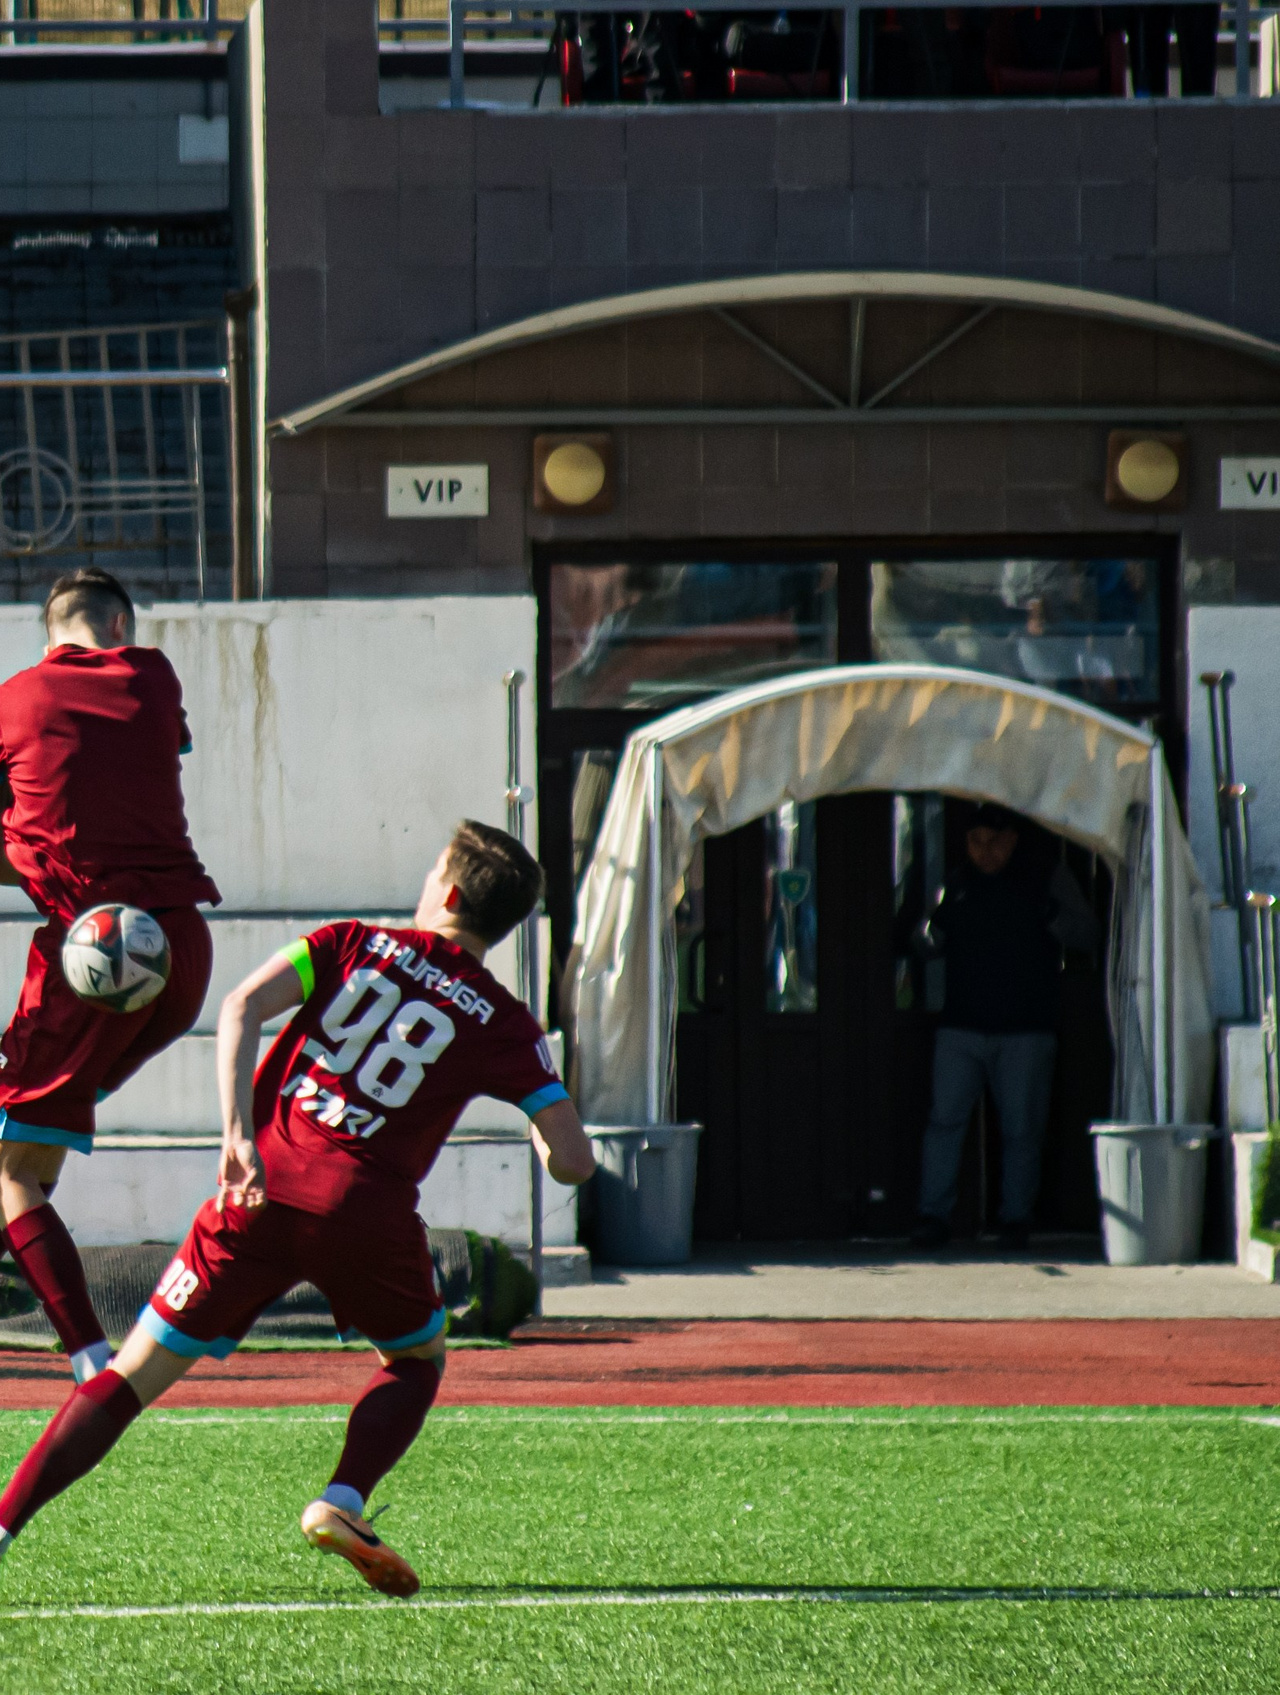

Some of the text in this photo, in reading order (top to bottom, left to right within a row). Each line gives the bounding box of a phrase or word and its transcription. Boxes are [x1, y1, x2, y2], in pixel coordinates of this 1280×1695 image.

[413, 479, 462, 503] VIP
[1246, 471, 1278, 496] VI
[365, 931, 495, 1025] SHURYGA
[301, 968, 456, 1108] 98
[280, 1073, 387, 1139] PARI
